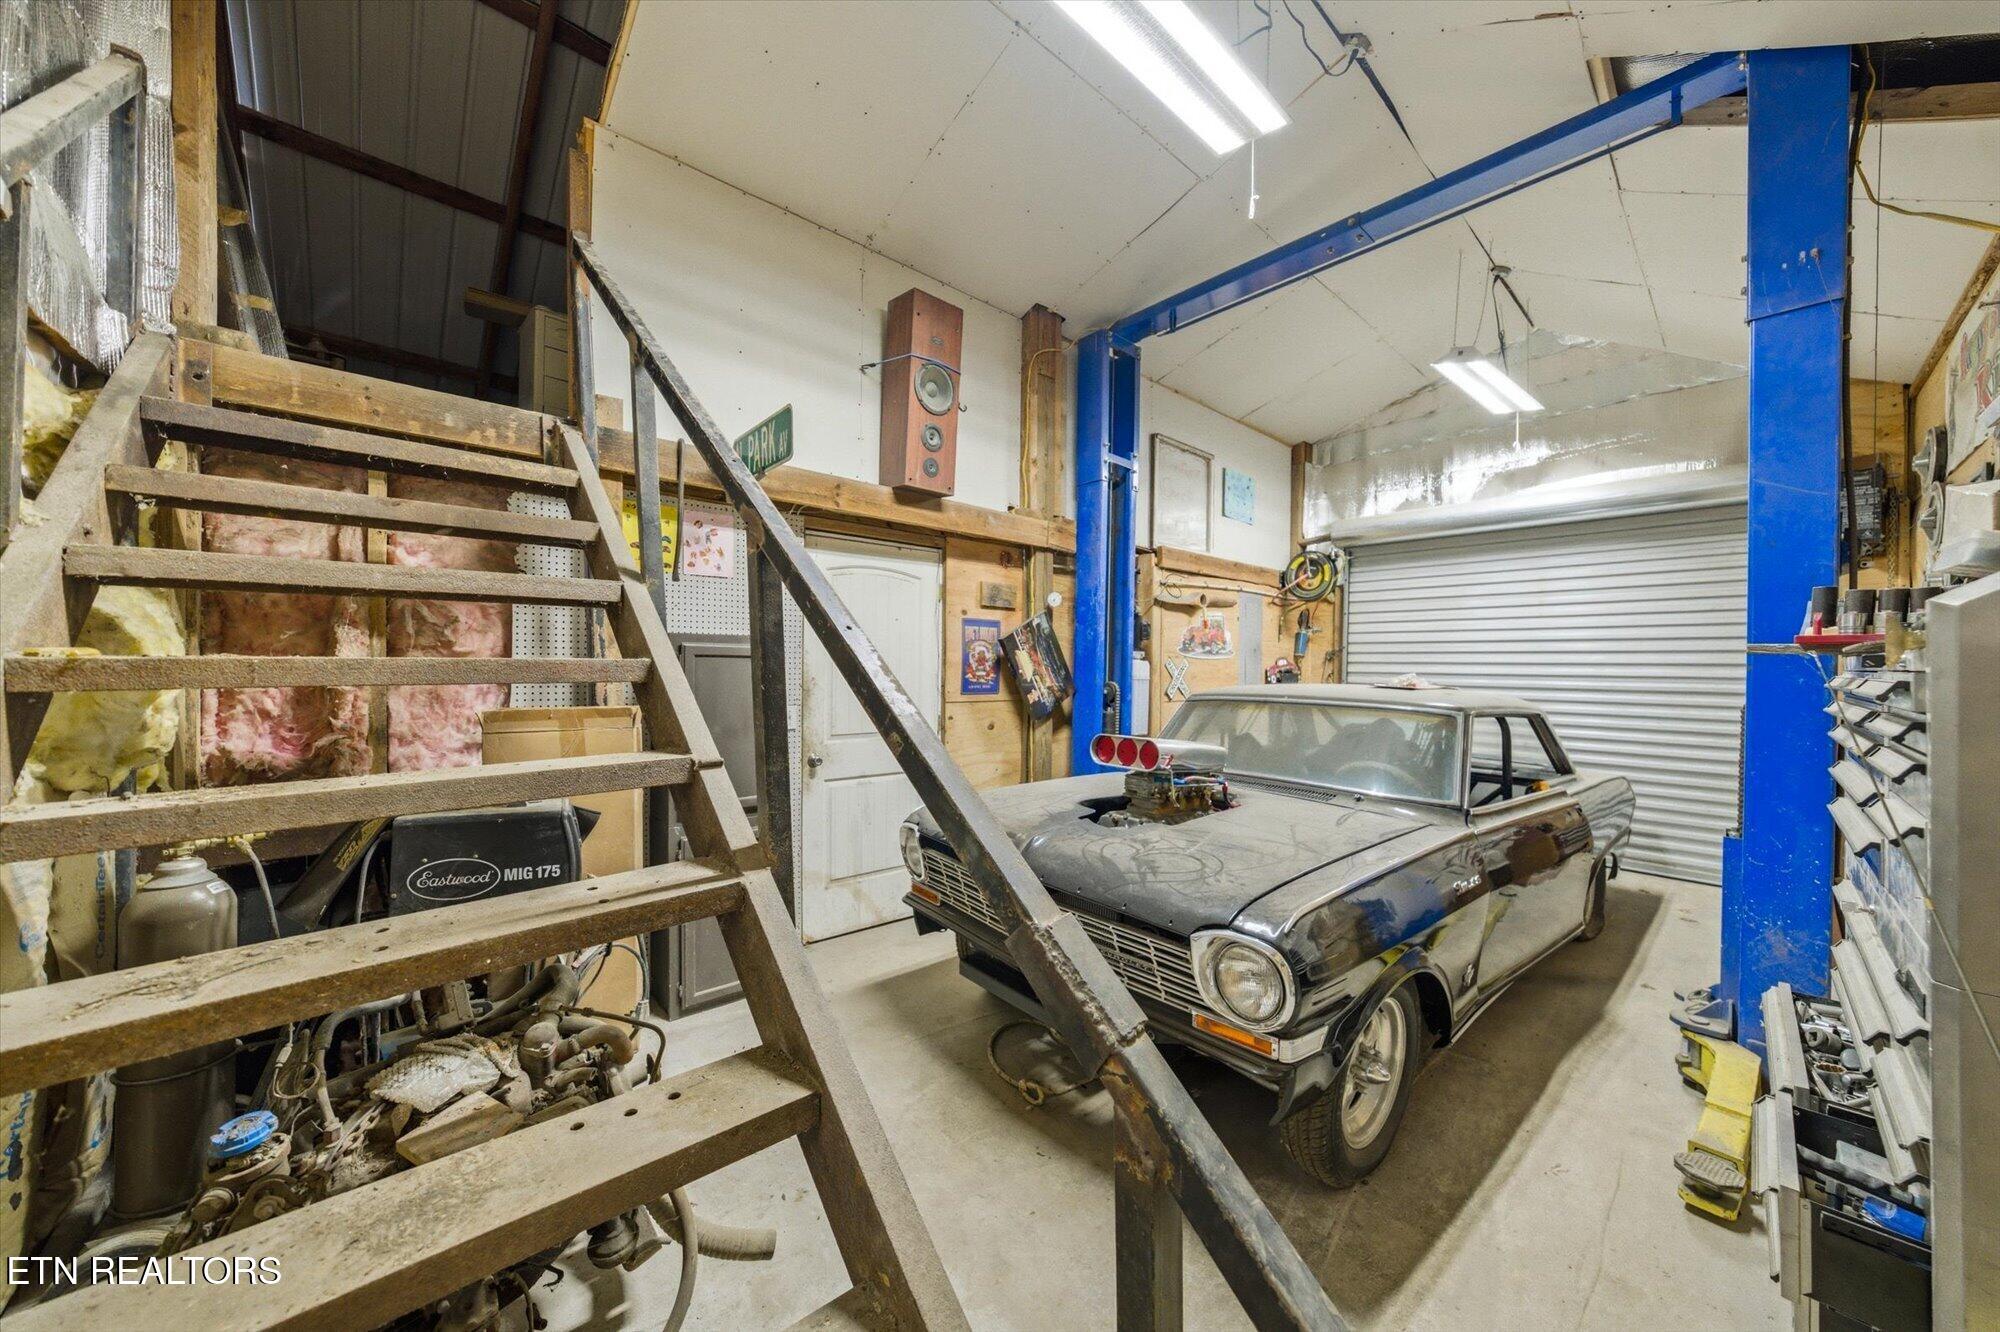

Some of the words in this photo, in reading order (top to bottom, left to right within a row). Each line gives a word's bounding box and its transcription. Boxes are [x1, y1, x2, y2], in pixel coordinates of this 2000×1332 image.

[748, 419, 776, 473] PARK
[416, 870, 491, 888] Eastwood
[504, 866, 533, 882] MIG
[535, 864, 561, 880] 175
